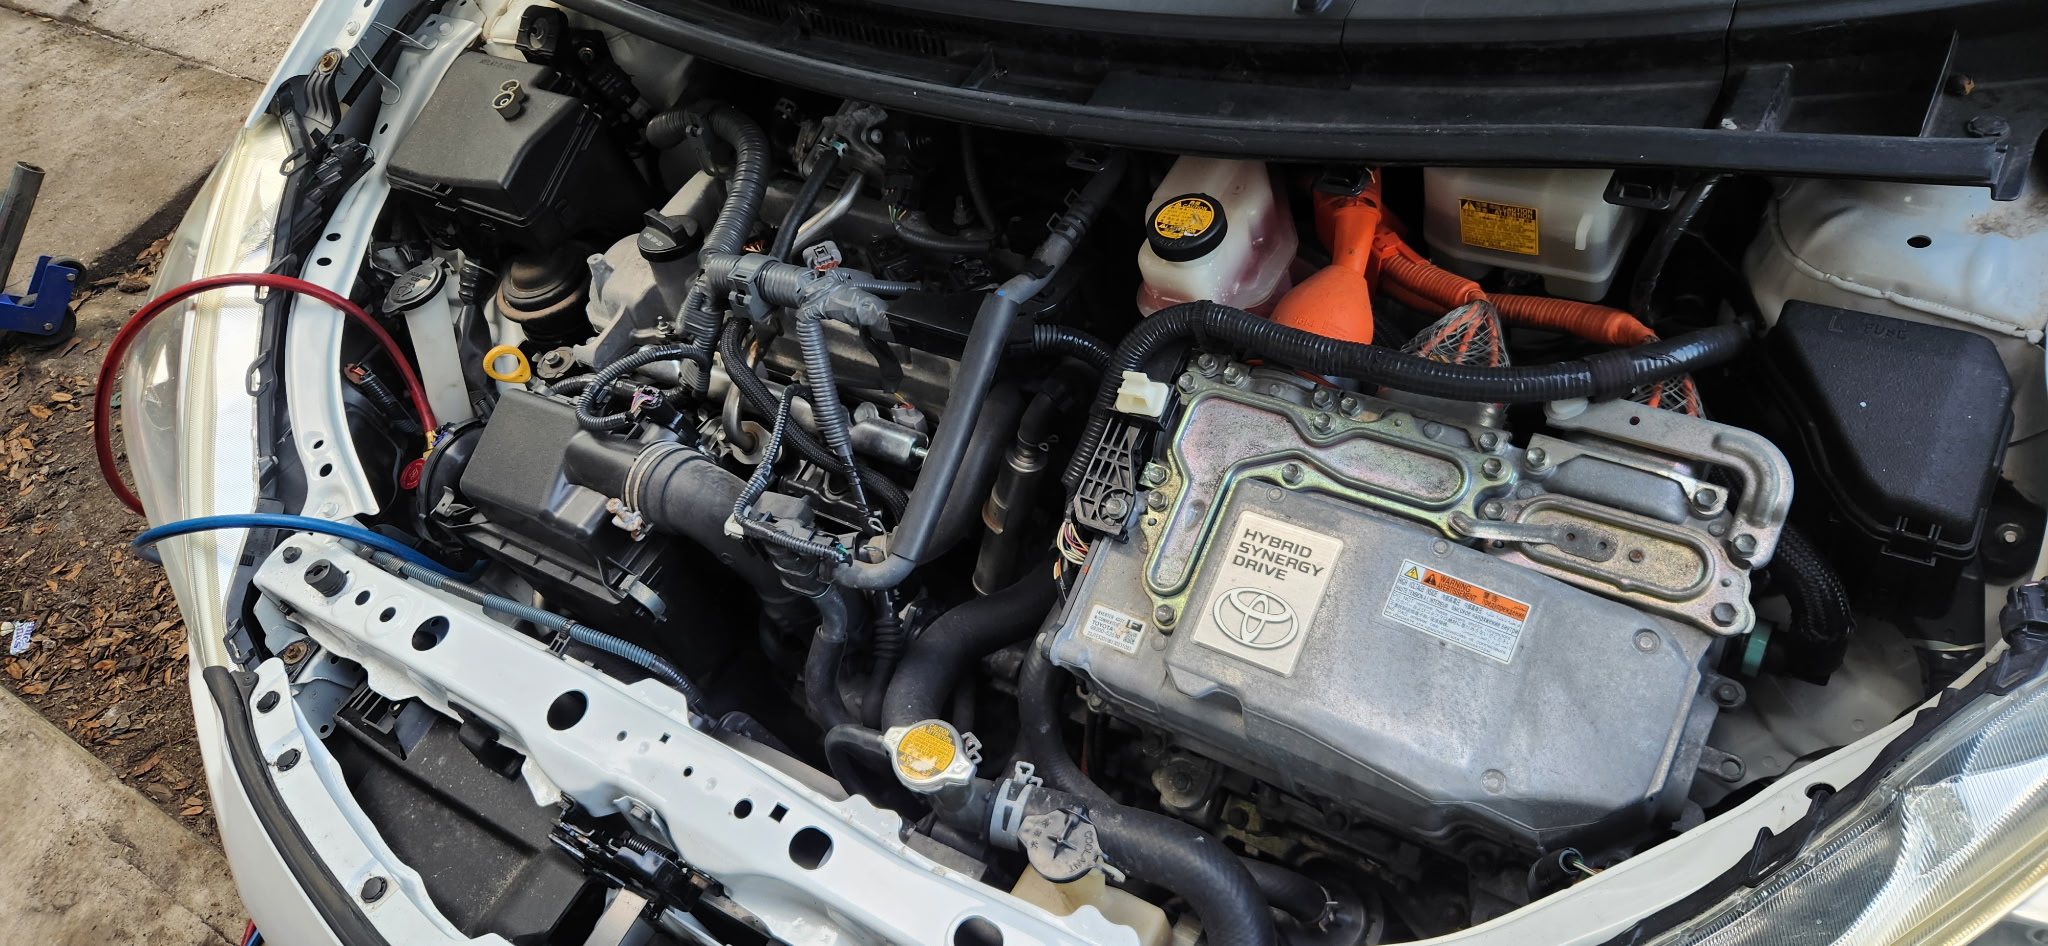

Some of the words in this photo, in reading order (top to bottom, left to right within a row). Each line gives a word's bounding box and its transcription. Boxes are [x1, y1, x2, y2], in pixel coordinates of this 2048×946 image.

[1243, 528, 1312, 558] HYBRID
[1231, 554, 1288, 581] DRIVE
[1237, 542, 1324, 577] SYNERGY
[1408, 581, 1425, 592] VOLTAGE
[1435, 581, 1477, 602] AVERTISSEMENT
[1439, 575, 1471, 592] WARNING
[1407, 589, 1423, 599] TENSION
[1091, 619, 1113, 631] TOYOTA
[926, 728, 953, 744] ATTENTION
[930, 723, 951, 737] CAUTION
[1069, 830, 1094, 873] COOLANT
